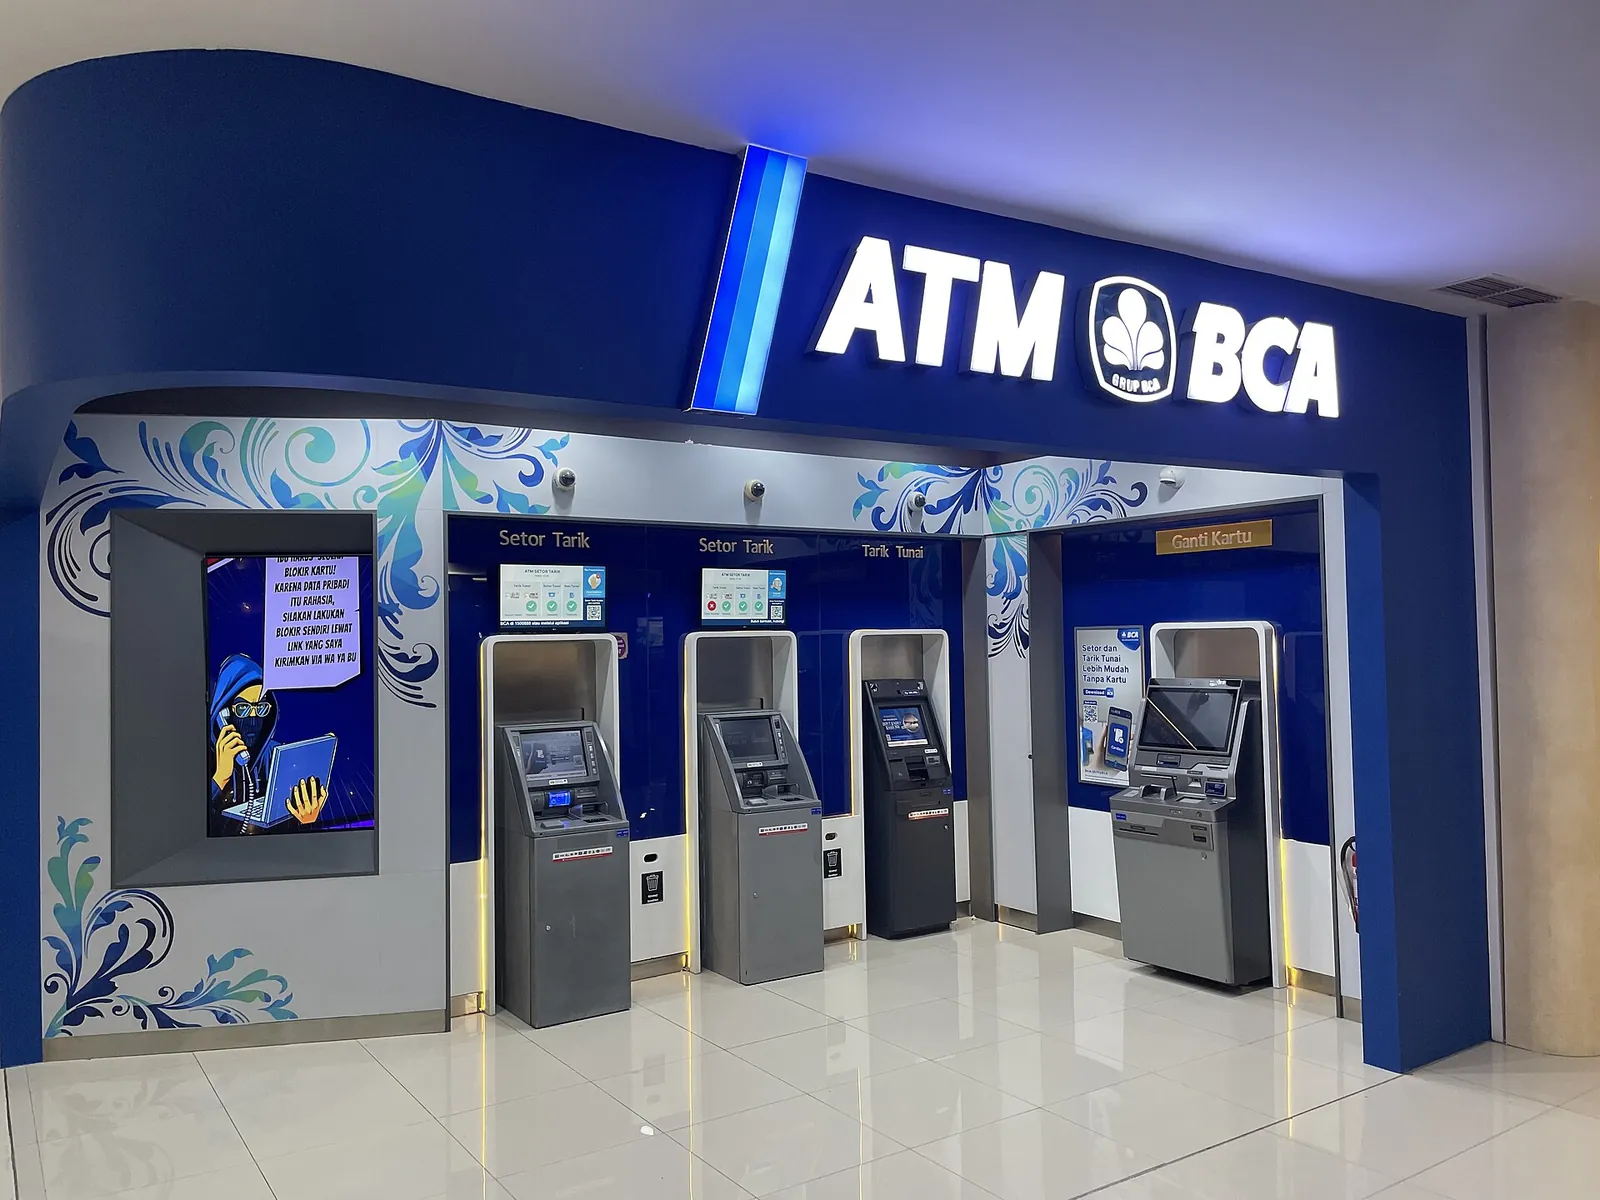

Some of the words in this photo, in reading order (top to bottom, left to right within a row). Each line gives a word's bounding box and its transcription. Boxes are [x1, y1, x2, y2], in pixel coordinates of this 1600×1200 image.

[815, 236, 1065, 381] ATM
[1187, 302, 1339, 418] BCA
[1112, 373, 1140, 392] GRUP
[1141, 377, 1161, 393] BCA
[499, 529, 546, 547] Setor
[551, 531, 590, 548] Tarik
[699, 537, 737, 552] Setor
[742, 539, 774, 554] Tarik
[1171, 532, 1208, 549] Ganti
[1211, 530, 1252, 546] Kartu
[861, 544, 889, 558] Tarik
[895, 545, 924, 559] Tunai
[284, 566, 309, 577] BLOKIR
[310, 565, 337, 576] KARTU!
[274, 581, 301, 593] KARENA
[303, 580, 320, 591] DATA
[322, 579, 350, 590] PRIBADI
[290, 596, 301, 607] ITU
[302, 595, 335, 606] RAHASIA,
[282, 610, 312, 622] SILAKAN
[313, 609, 345, 620] LAKUKAN
[276, 626, 301, 638] BLOKIR
[302, 624, 330, 636] SENDIRI
[331, 623, 353, 634] LEWAT
[1127, 631, 1139, 639] BCA
[287, 641, 303, 652] LINK
[304, 639, 323, 650] YANG
[325, 638, 342, 649] SAYA
[1082, 644, 1102, 652] Setor
[274, 655, 309, 668] KIRIMKAN
[311, 654, 322, 665] VIA
[324, 653, 335, 664] WA
[337, 652, 346, 663] YA
[347, 652, 357, 663] BU
[1082, 654, 1100, 662] Tarik
[1104, 665, 1129, 673] Mudah
[1082, 675, 1105, 684] Tanpa
[1106, 675, 1127, 683] Kartu
